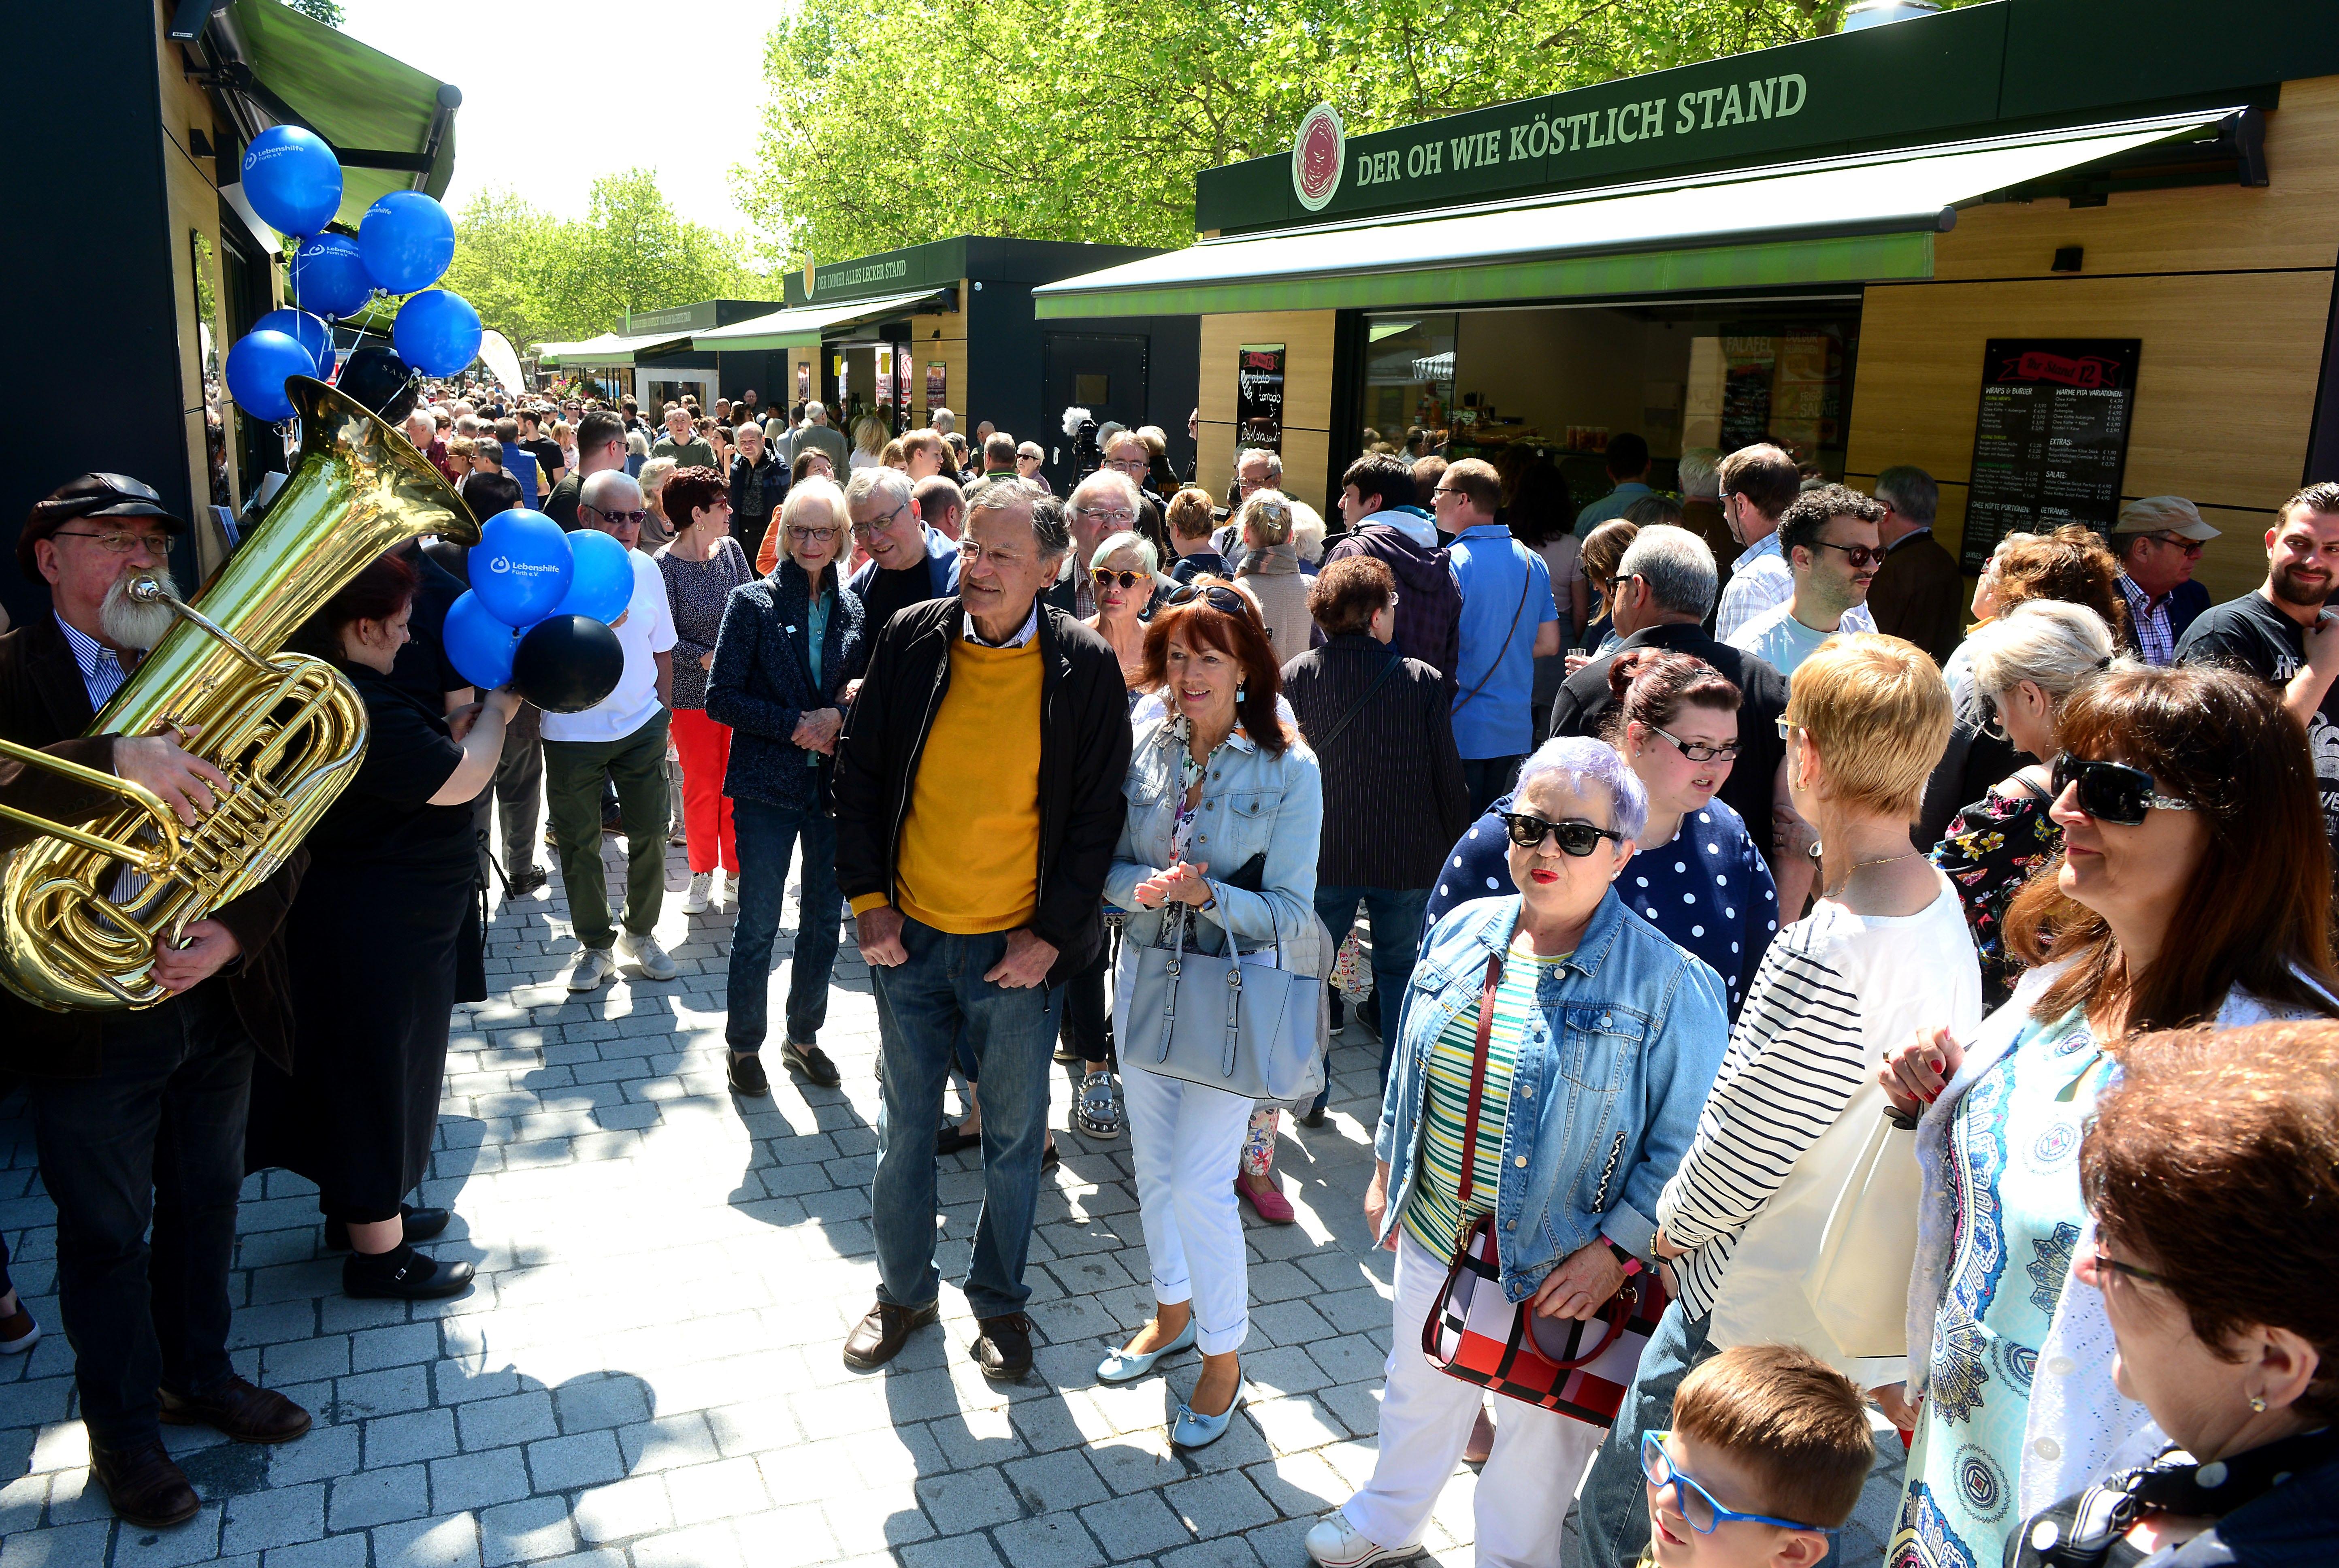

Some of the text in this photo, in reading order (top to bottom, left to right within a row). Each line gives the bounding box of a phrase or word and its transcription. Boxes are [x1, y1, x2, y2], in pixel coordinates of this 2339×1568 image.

[1357, 73, 1807, 187] DER OH WIE KÖSTLICH STAND
[258, 145, 304, 157] Lebenshilfe
[818, 260, 906, 290] DER IMMER ALLES LECKER STAND
[1252, 369, 1270, 394] potato
[2078, 365, 2096, 383] 12
[1259, 386, 1281, 403] tornado
[1241, 422, 1265, 442] Baklava
[512, 562, 559, 572] Lebenshilfe
